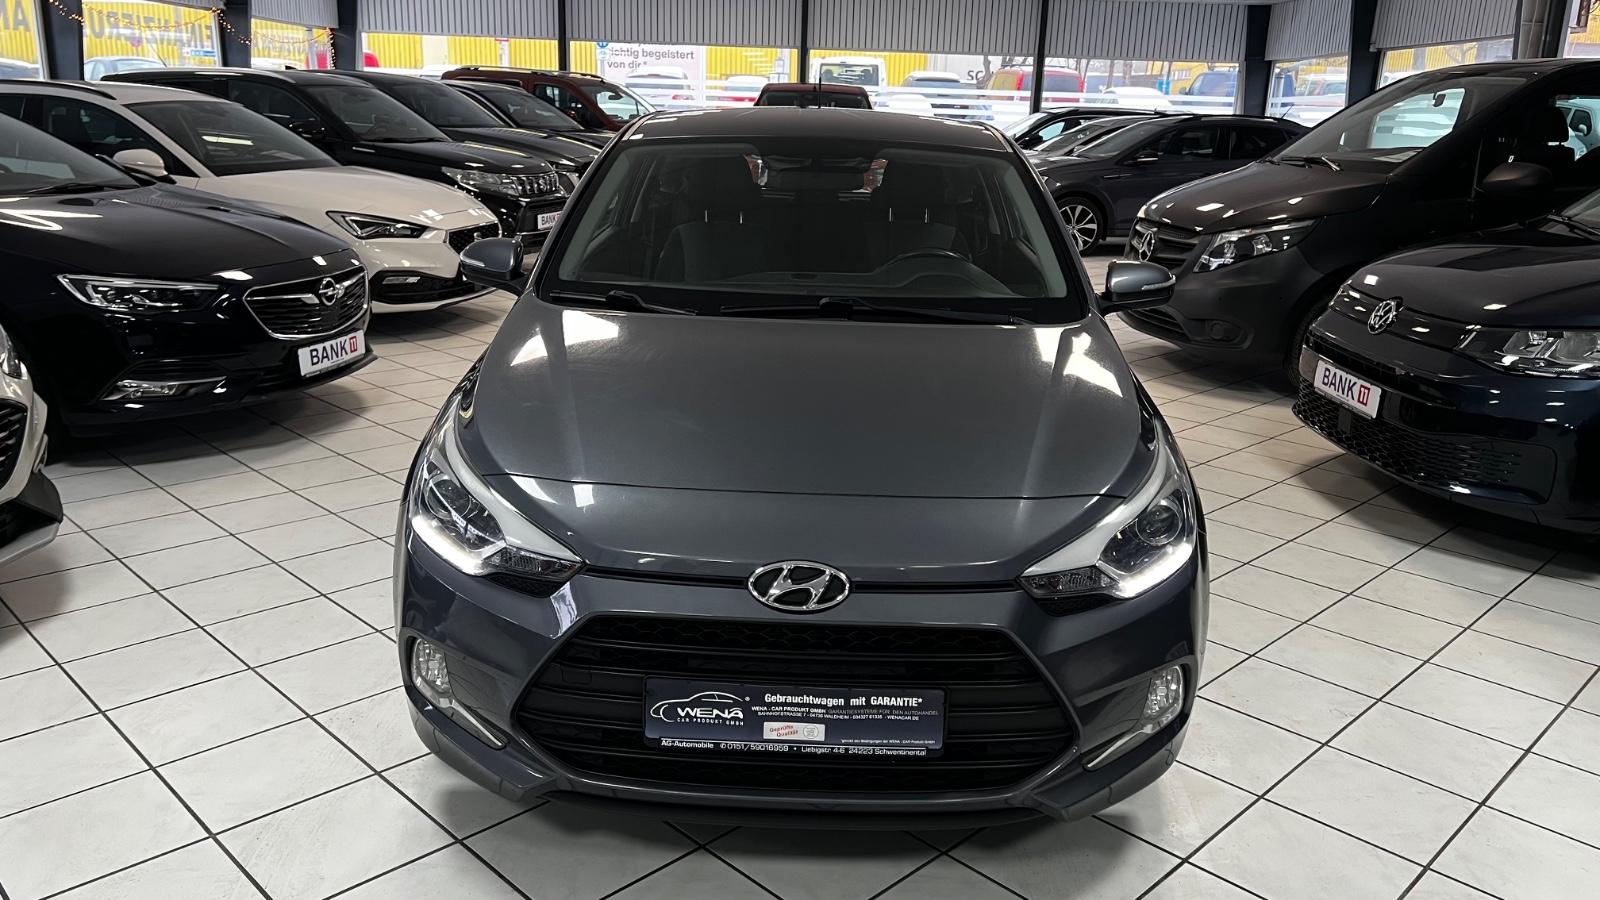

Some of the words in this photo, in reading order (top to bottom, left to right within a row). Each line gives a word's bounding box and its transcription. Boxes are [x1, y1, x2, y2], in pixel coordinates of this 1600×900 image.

[609, 47, 639, 59] ichtig
[641, 48, 695, 60] begeistert
[310, 339, 348, 366] BANK
[1322, 367, 1357, 400] BANK
[765, 693, 845, 707] Gebrauchtwagen
[850, 696, 866, 706] mit
[677, 707, 743, 719] WENA
[661, 740, 714, 749] AG-Automobile
